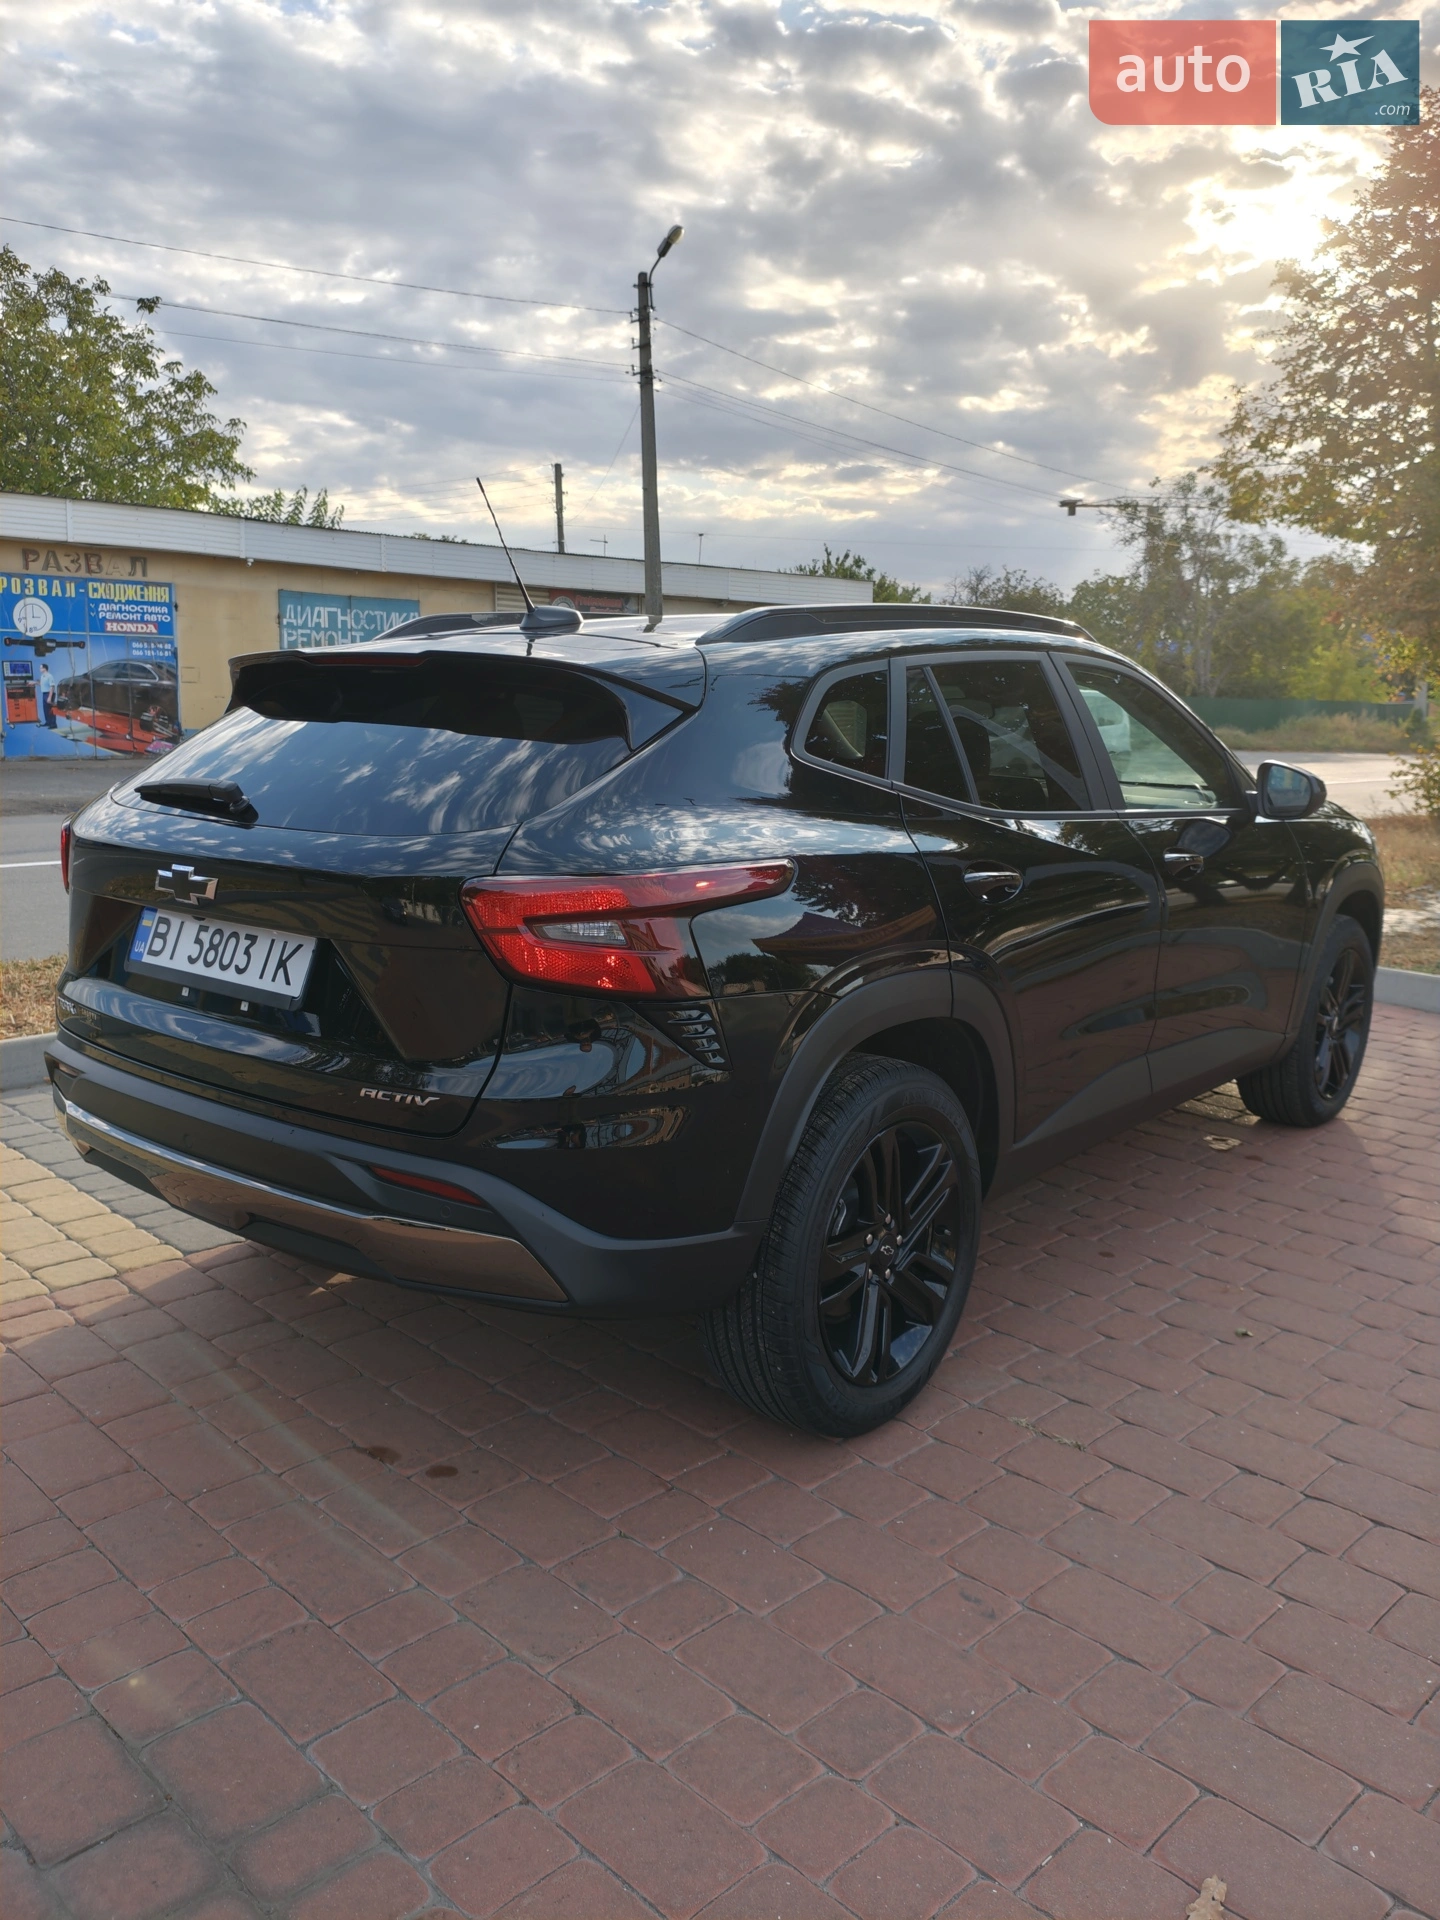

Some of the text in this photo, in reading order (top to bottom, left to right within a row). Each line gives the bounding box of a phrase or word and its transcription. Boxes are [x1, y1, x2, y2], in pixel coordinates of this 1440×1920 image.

[21, 548, 148, 577] РАЗВАЛ
[98, 603, 168, 614] ДІАГНОСТИКА
[99, 612, 171, 622] РЕМОНТ АВТО
[105, 622, 158, 633] HONDA
[134, 940, 145, 954] UA
[147, 917, 304, 986] BI 5803 IK
[359, 1087, 440, 1107] ACTIV
